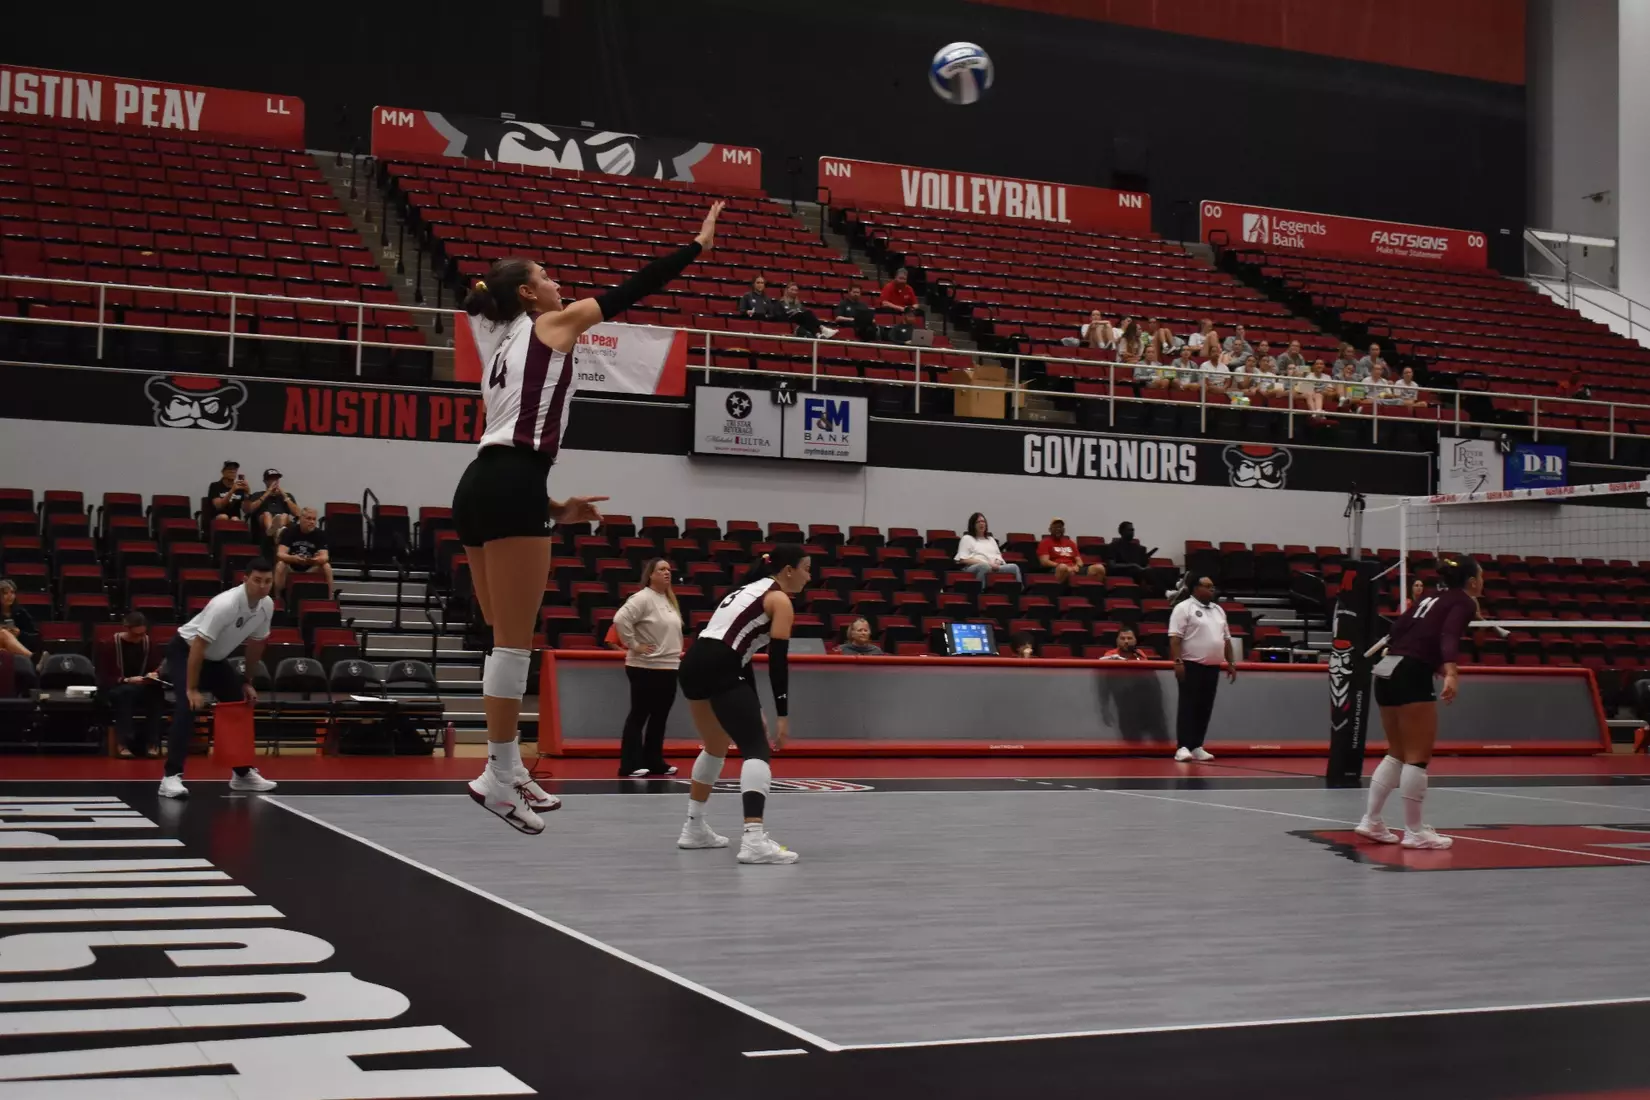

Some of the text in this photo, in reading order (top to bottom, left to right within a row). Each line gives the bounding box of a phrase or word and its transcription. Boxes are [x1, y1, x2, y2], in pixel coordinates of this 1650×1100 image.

[115, 82, 206, 132] PEAY
[266, 97, 291, 115] LL
[380, 109, 415, 128] MM
[722, 147, 752, 165] MM
[825, 161, 851, 178] NN
[901, 168, 1072, 225] VOLLEYBALL
[1118, 193, 1143, 209] NN
[1272, 216, 1327, 236] Legends
[1272, 232, 1305, 249] Bank
[1370, 231, 1449, 251] FASTSIGNS
[592, 334, 619, 350] Peay
[488, 351, 508, 390] 4
[777, 391, 792, 404] M
[283, 386, 418, 438] AUSTIN
[804, 432, 849, 443] BANK
[1500, 441, 1511, 452] N
[1023, 433, 1197, 483] GOVERNORS
[1412, 596, 1440, 619] 11
